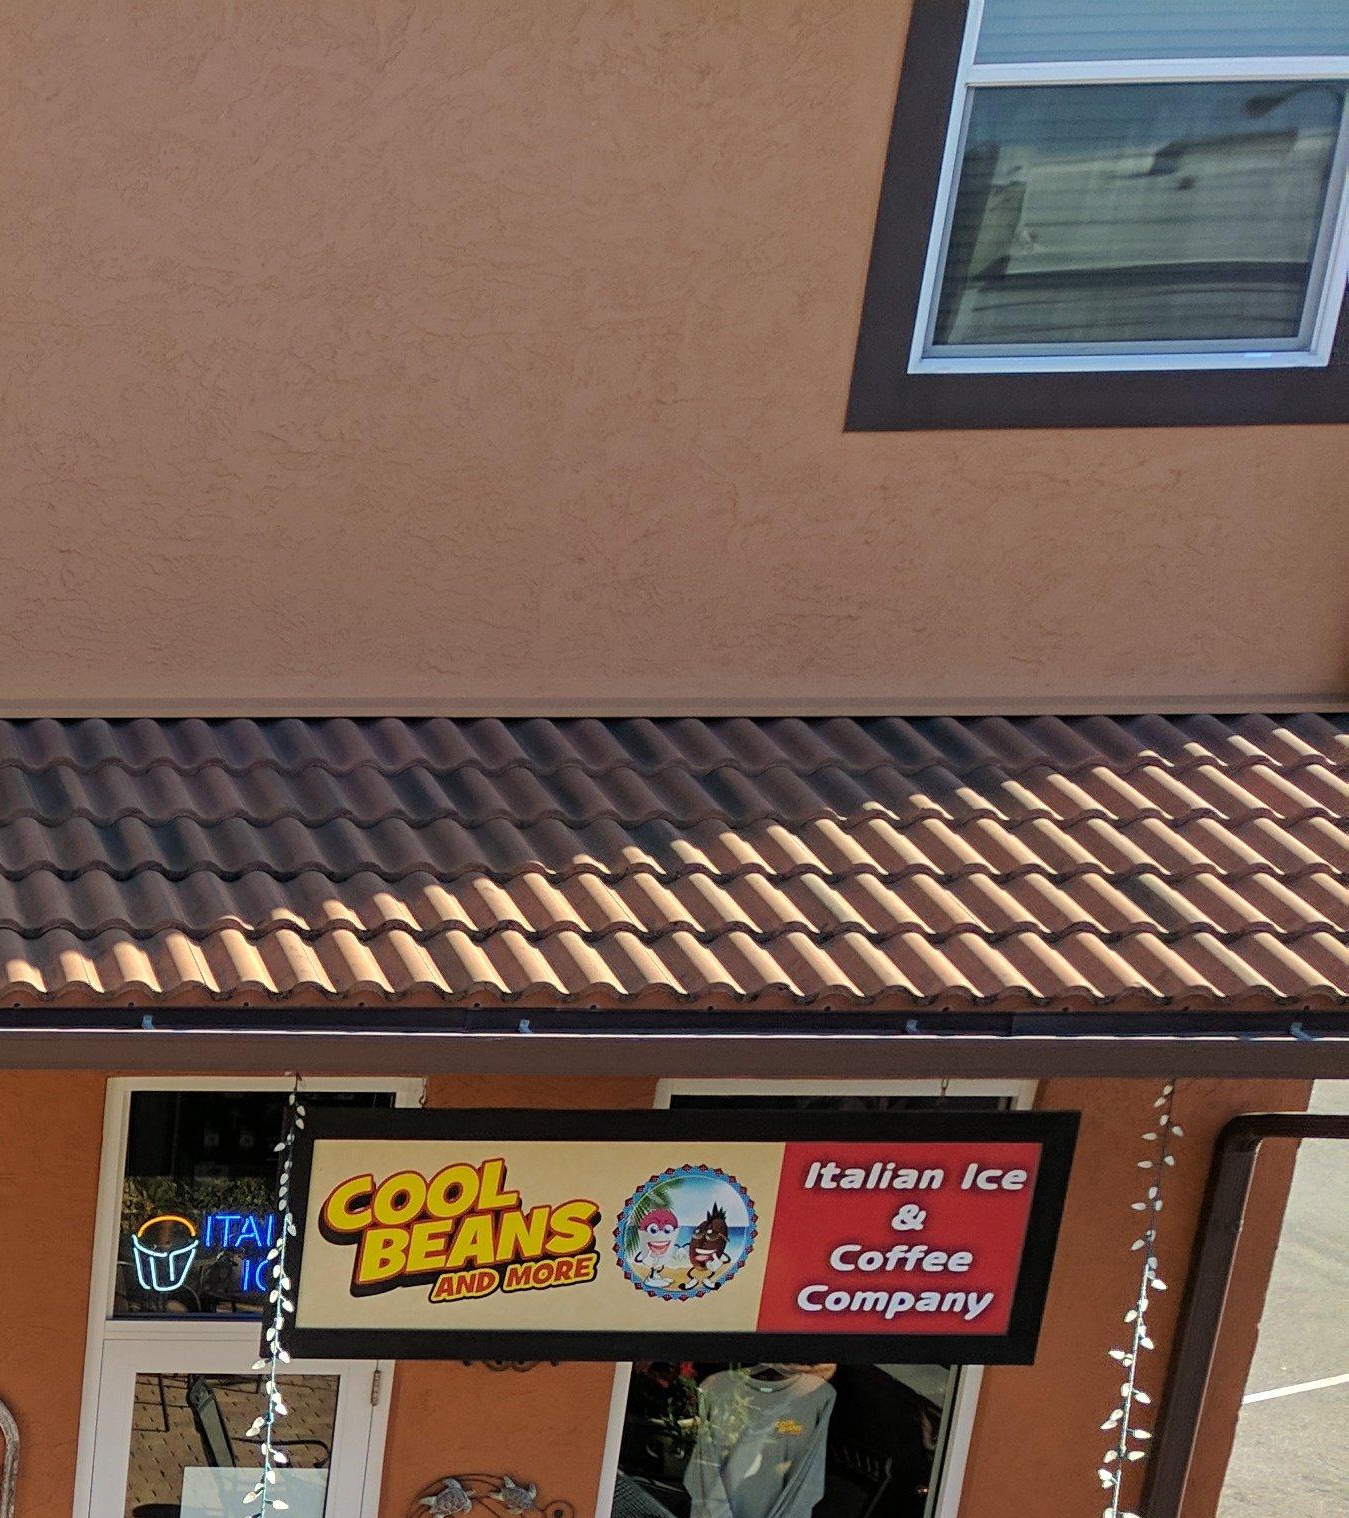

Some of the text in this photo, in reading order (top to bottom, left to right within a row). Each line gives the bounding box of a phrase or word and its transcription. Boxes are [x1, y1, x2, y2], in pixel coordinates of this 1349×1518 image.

[804, 1161, 1028, 1191] Italian Ice
[320, 1157, 521, 1242] COOL
[891, 1203, 927, 1231] &
[352, 1199, 600, 1290] BEANS
[829, 1243, 974, 1272] Coffee
[243, 1259, 269, 1292] IC
[433, 1256, 595, 1300] AND MORE
[797, 1284, 995, 1321] Company
